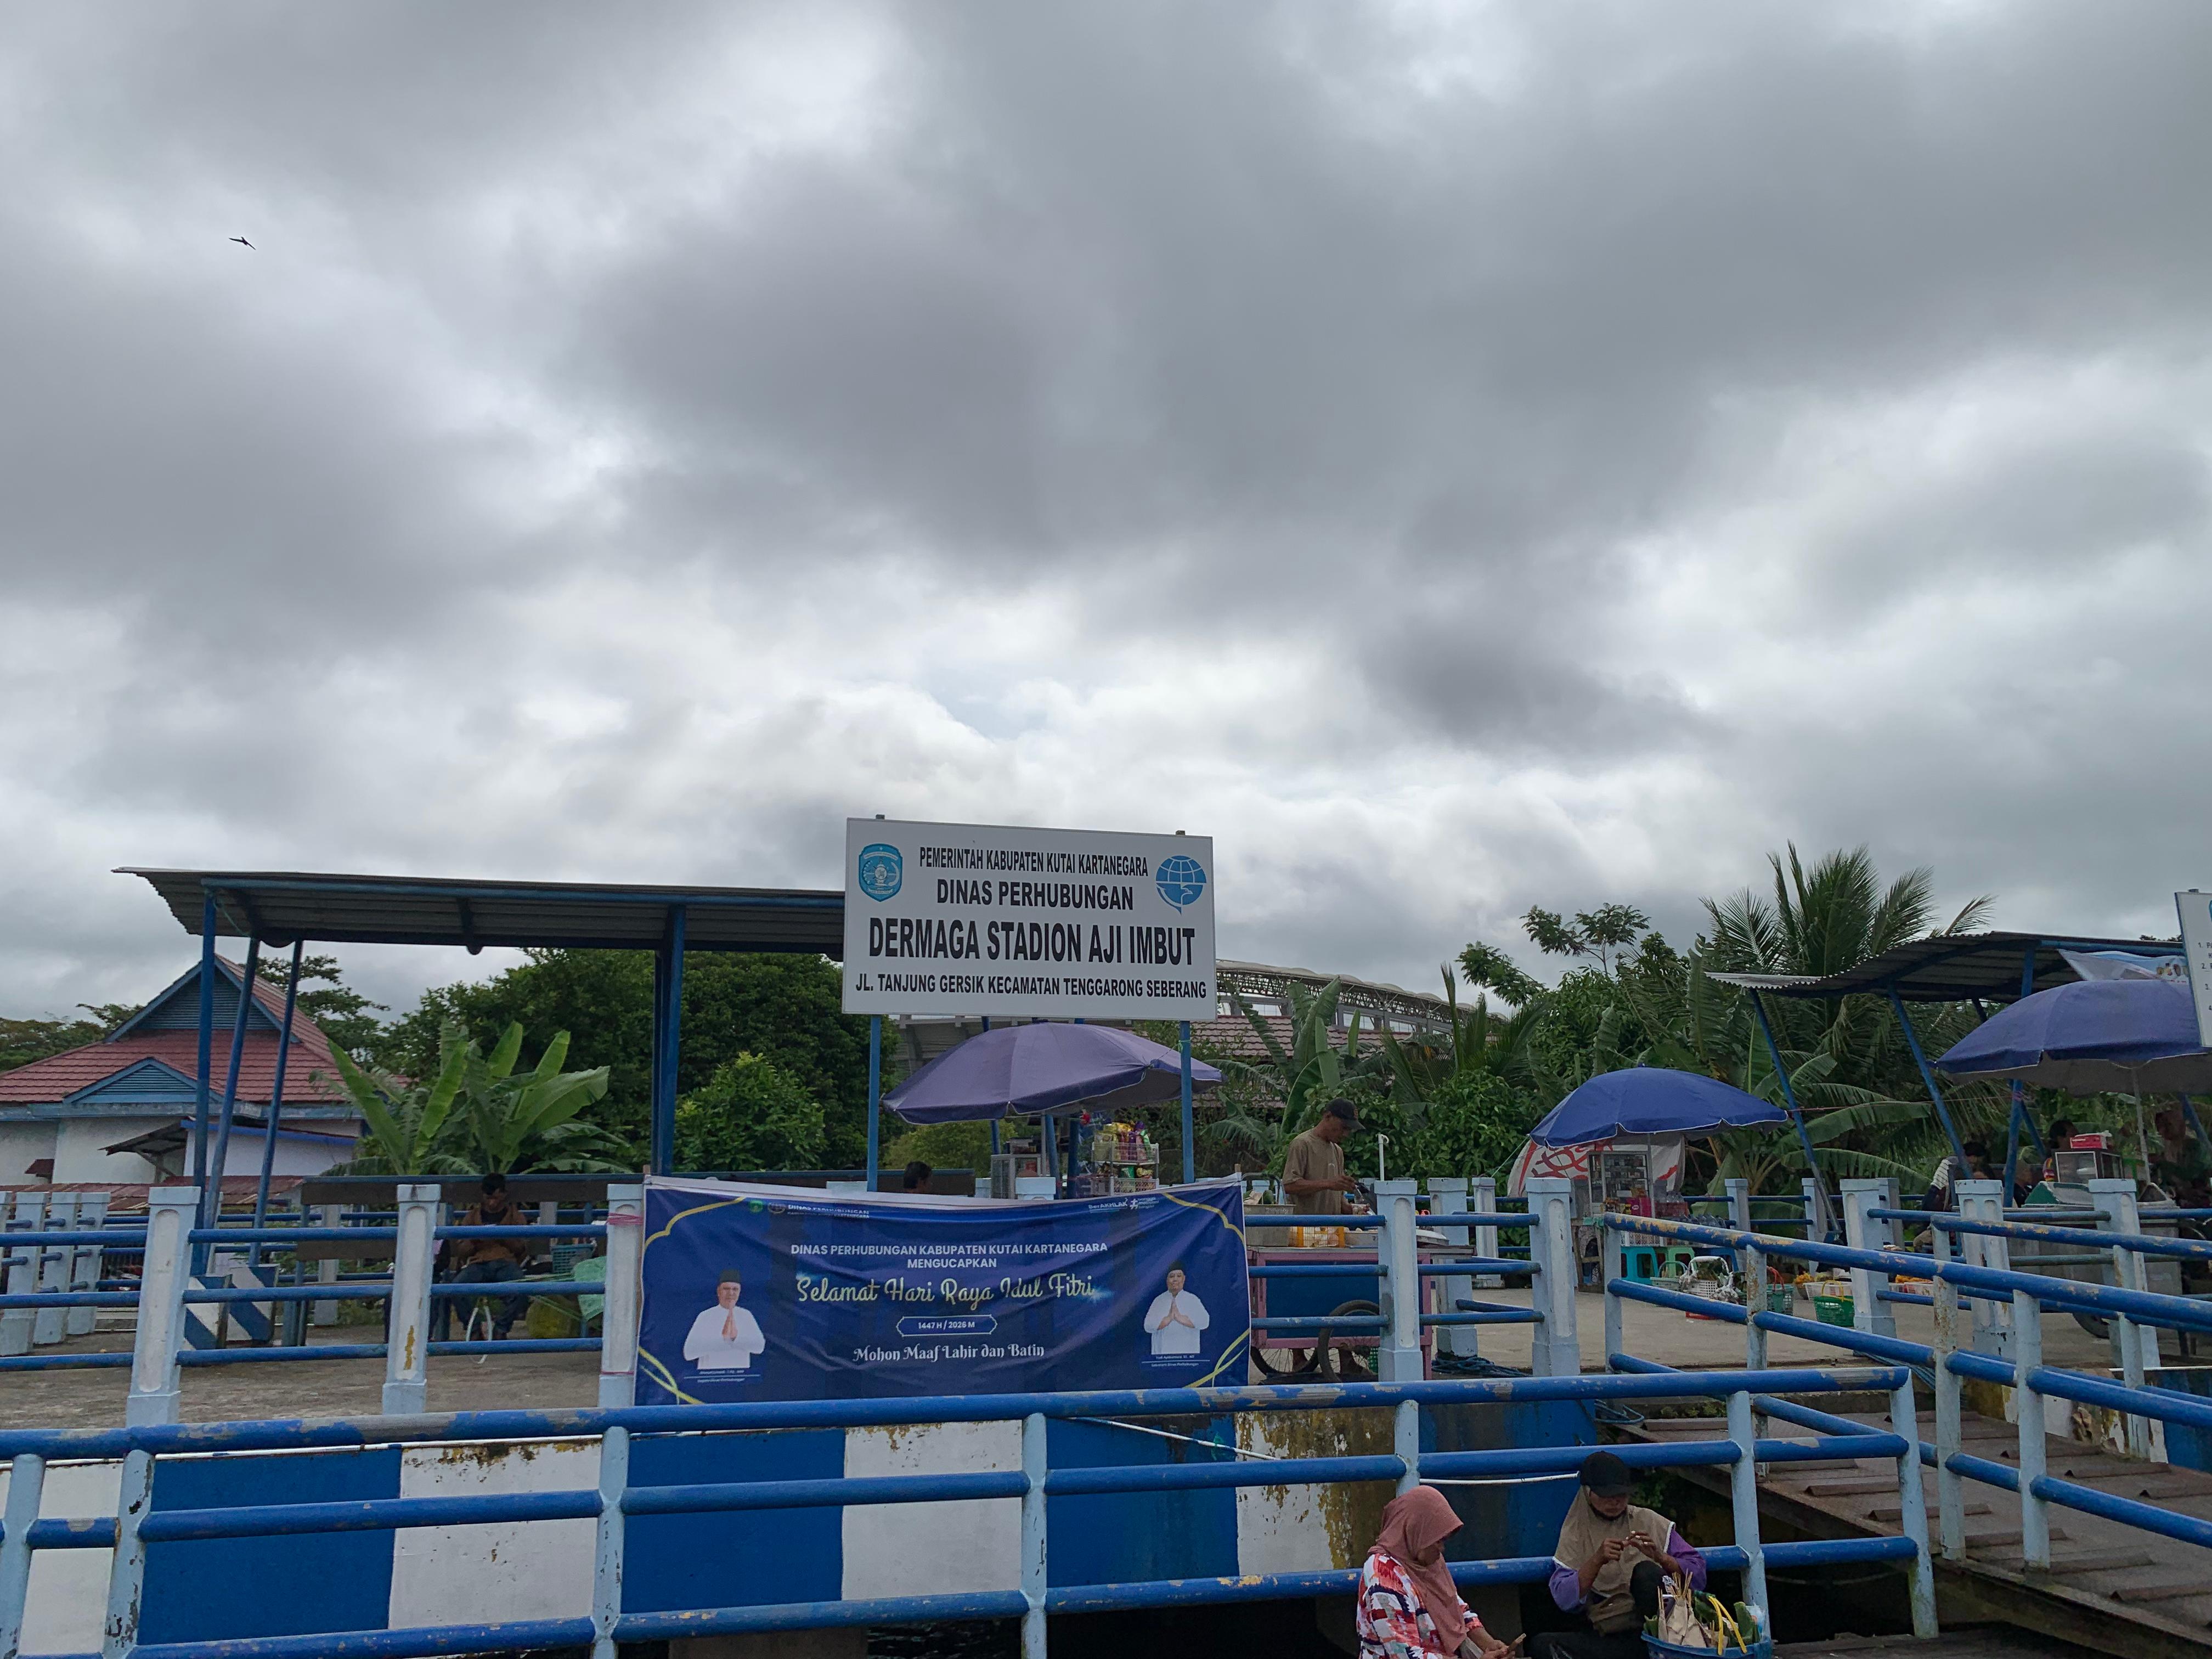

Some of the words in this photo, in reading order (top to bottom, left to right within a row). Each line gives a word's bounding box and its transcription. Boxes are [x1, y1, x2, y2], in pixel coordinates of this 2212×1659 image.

[919, 847, 983, 869] PEMERINTAH
[986, 850, 1043, 872] KABUPATEN
[1047, 853, 1075, 873] KUTAI
[1079, 854, 1148, 876] KARTANEGARA
[937, 879, 992, 905] DINAS
[998, 881, 1133, 910] PERHUBUNGAN
[870, 917, 980, 959] DERMAGA
[987, 921, 1081, 962] STADION
[1088, 924, 1121, 963] AJI
[1130, 926, 1195, 965] IMBUT
[856, 973, 873, 991] JL.
[878, 974, 935, 992] TANJUNG
[940, 975, 984, 993] GERSIK
[988, 976, 1059, 995] KECAMATAN
[1063, 978, 1143, 997] TENGGARONG
[1147, 980, 1206, 998] SEBERANG
[791, 1245, 827, 1254] DINAS
[831, 1245, 917, 1255] PERHUBUNGAN
[919, 1245, 986, 1255] KABUPATEN
[989, 1245, 1023, 1254] KUTAI
[1025, 1243, 1108, 1254] KARTANEGARA
[907, 1258, 997, 1268] MENGUCAPKAN
[797, 1277, 881, 1301] Selamat
[884, 1277, 935, 1301] Hari
[940, 1278, 994, 1311] Raya
[1000, 1277, 1043, 1298] Idul
[1048, 1273, 1096, 1298] Fitri
[853, 1345, 900, 1362] Mohon
[904, 1344, 940, 1362] Maaf
[942, 1345, 978, 1359] Lahir
[981, 1344, 1005, 1358] dan
[1008, 1344, 1045, 1357] Batin
